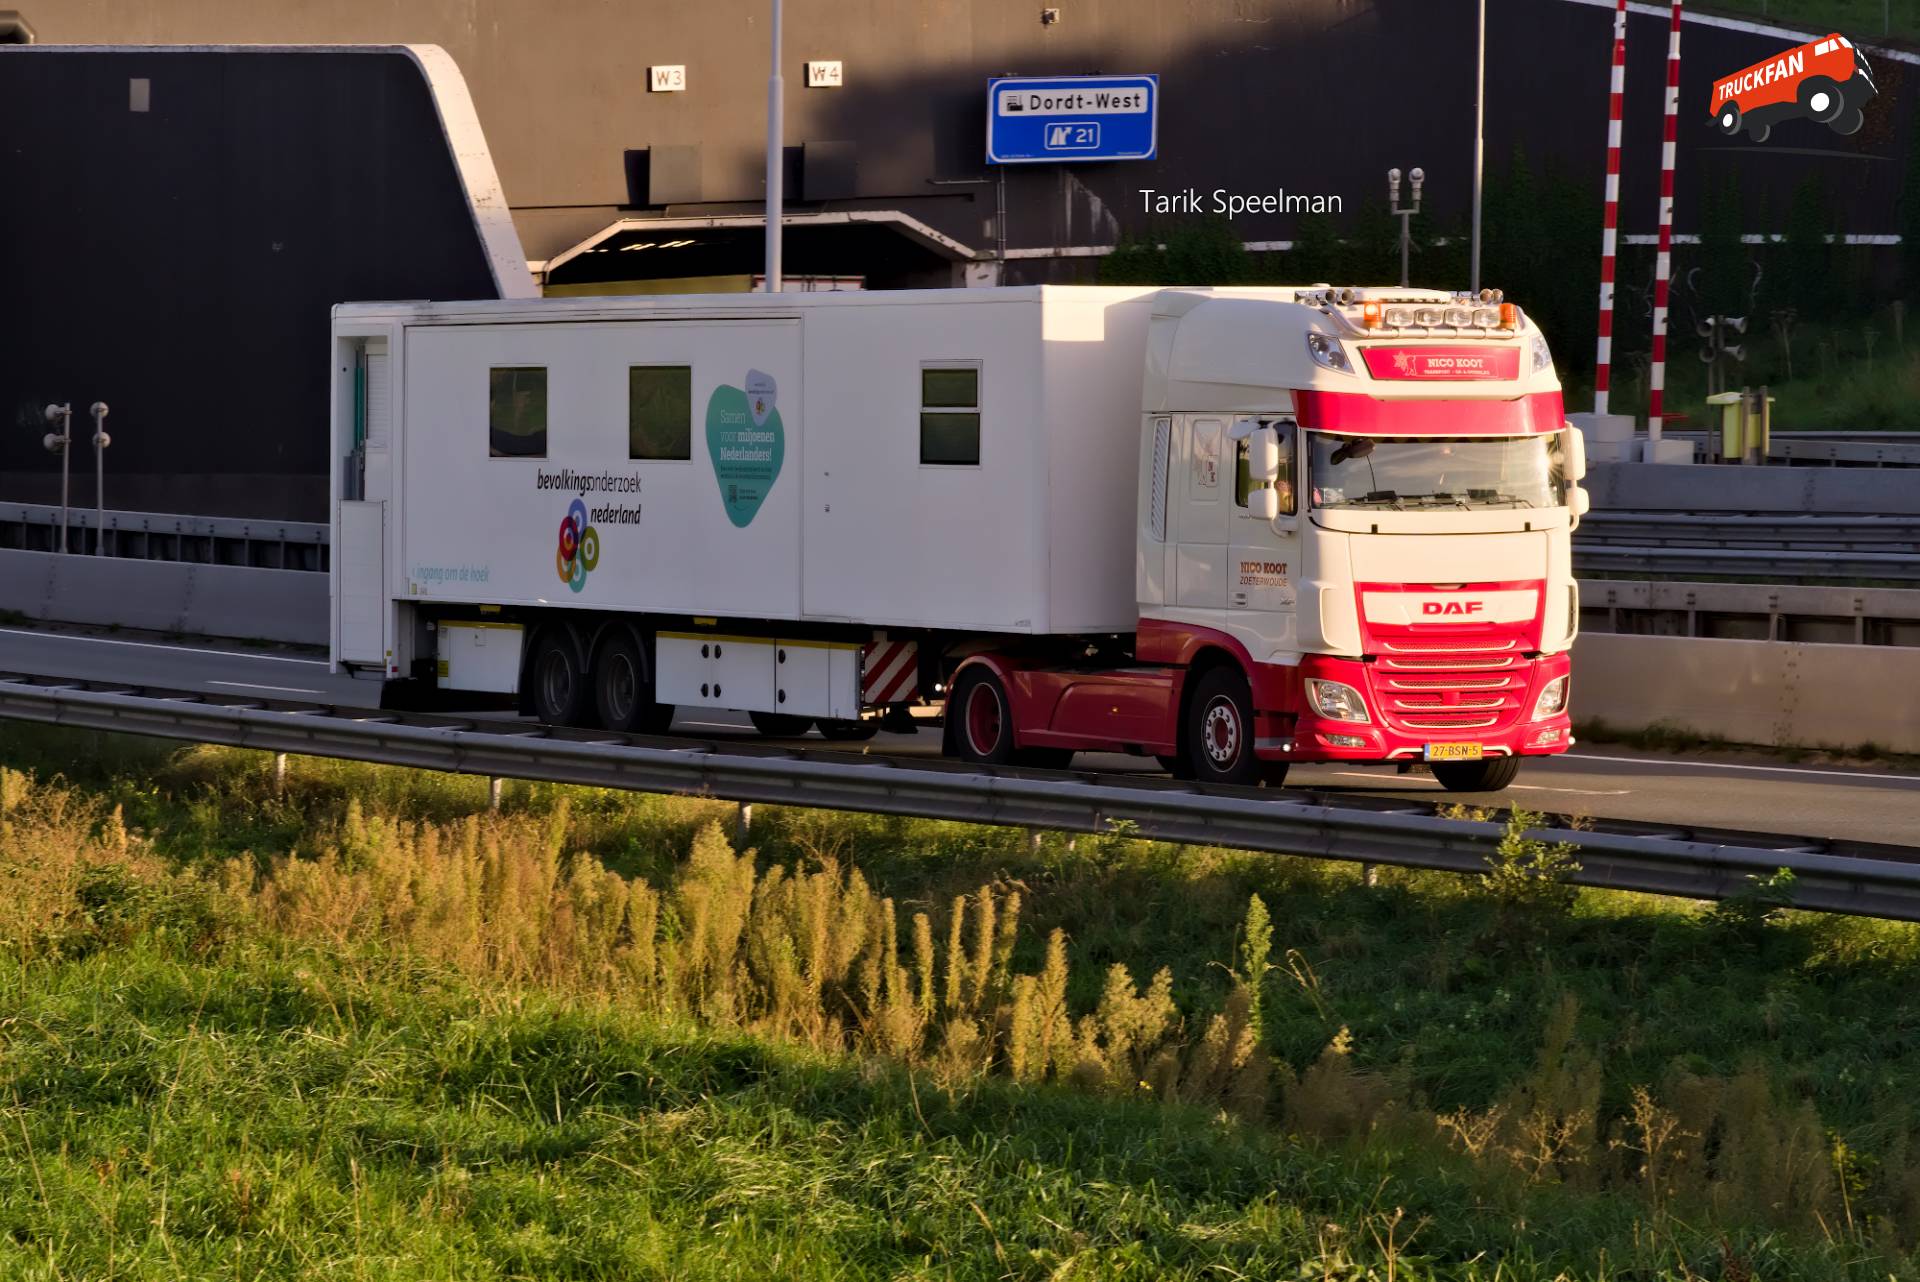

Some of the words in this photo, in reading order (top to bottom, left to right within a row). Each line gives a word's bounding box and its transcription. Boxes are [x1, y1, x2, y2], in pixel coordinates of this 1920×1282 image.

[1030, 93, 1141, 110] Dordt-West
[1075, 128, 1093, 143] 21
[1428, 358, 1454, 368] NICO
[1456, 358, 1484, 368] KOOT
[720, 408, 745, 425] Samen
[737, 428, 775, 446] miljoenen
[537, 468, 641, 497] bevolkingsonderzoek
[590, 503, 641, 525] nederland
[445, 568, 458, 581] om
[459, 563, 469, 581] de
[1240, 561, 1261, 573] NICO
[1263, 562, 1287, 574] KOOT
[1422, 601, 1483, 615] DAF
[1433, 745, 1478, 757] 27-BSN-5
